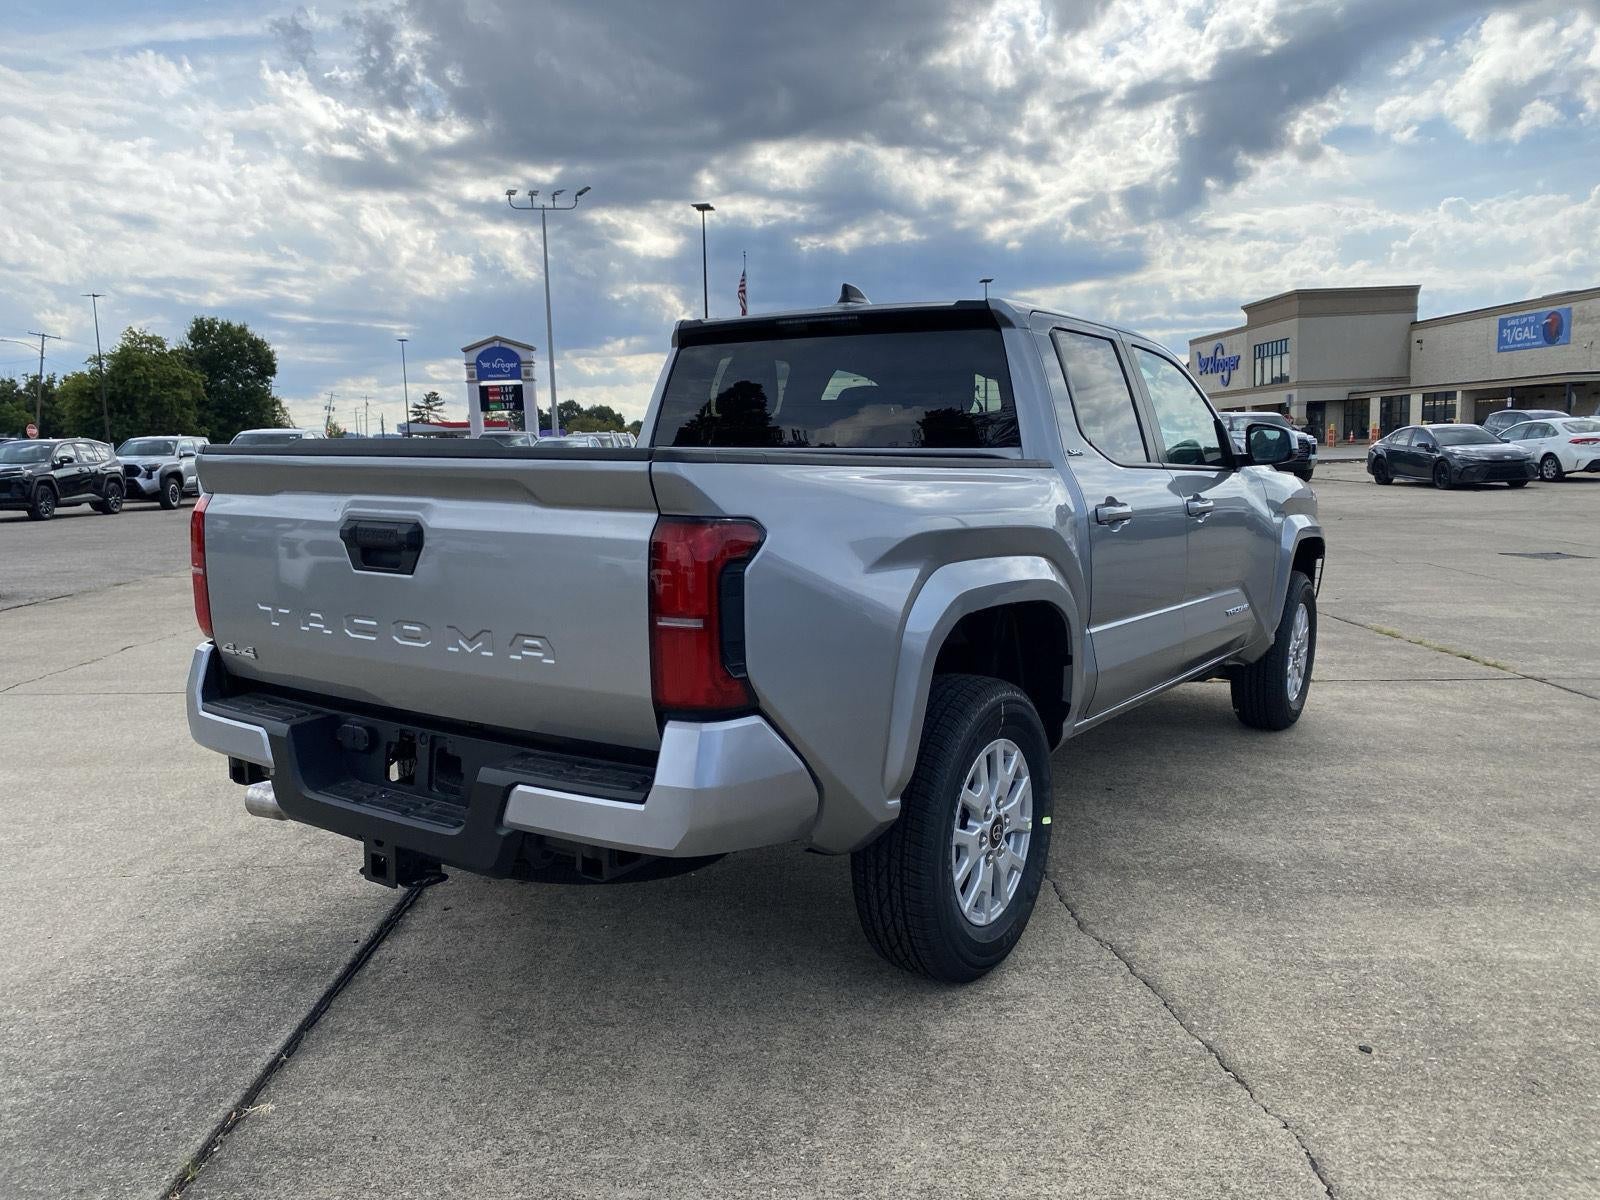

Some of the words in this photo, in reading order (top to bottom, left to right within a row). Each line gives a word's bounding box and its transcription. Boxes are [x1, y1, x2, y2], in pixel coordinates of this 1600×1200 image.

[492, 358, 518, 373] Kroger
[1210, 342, 1241, 387] Kroger
[257, 602, 555, 664] TACOMA
